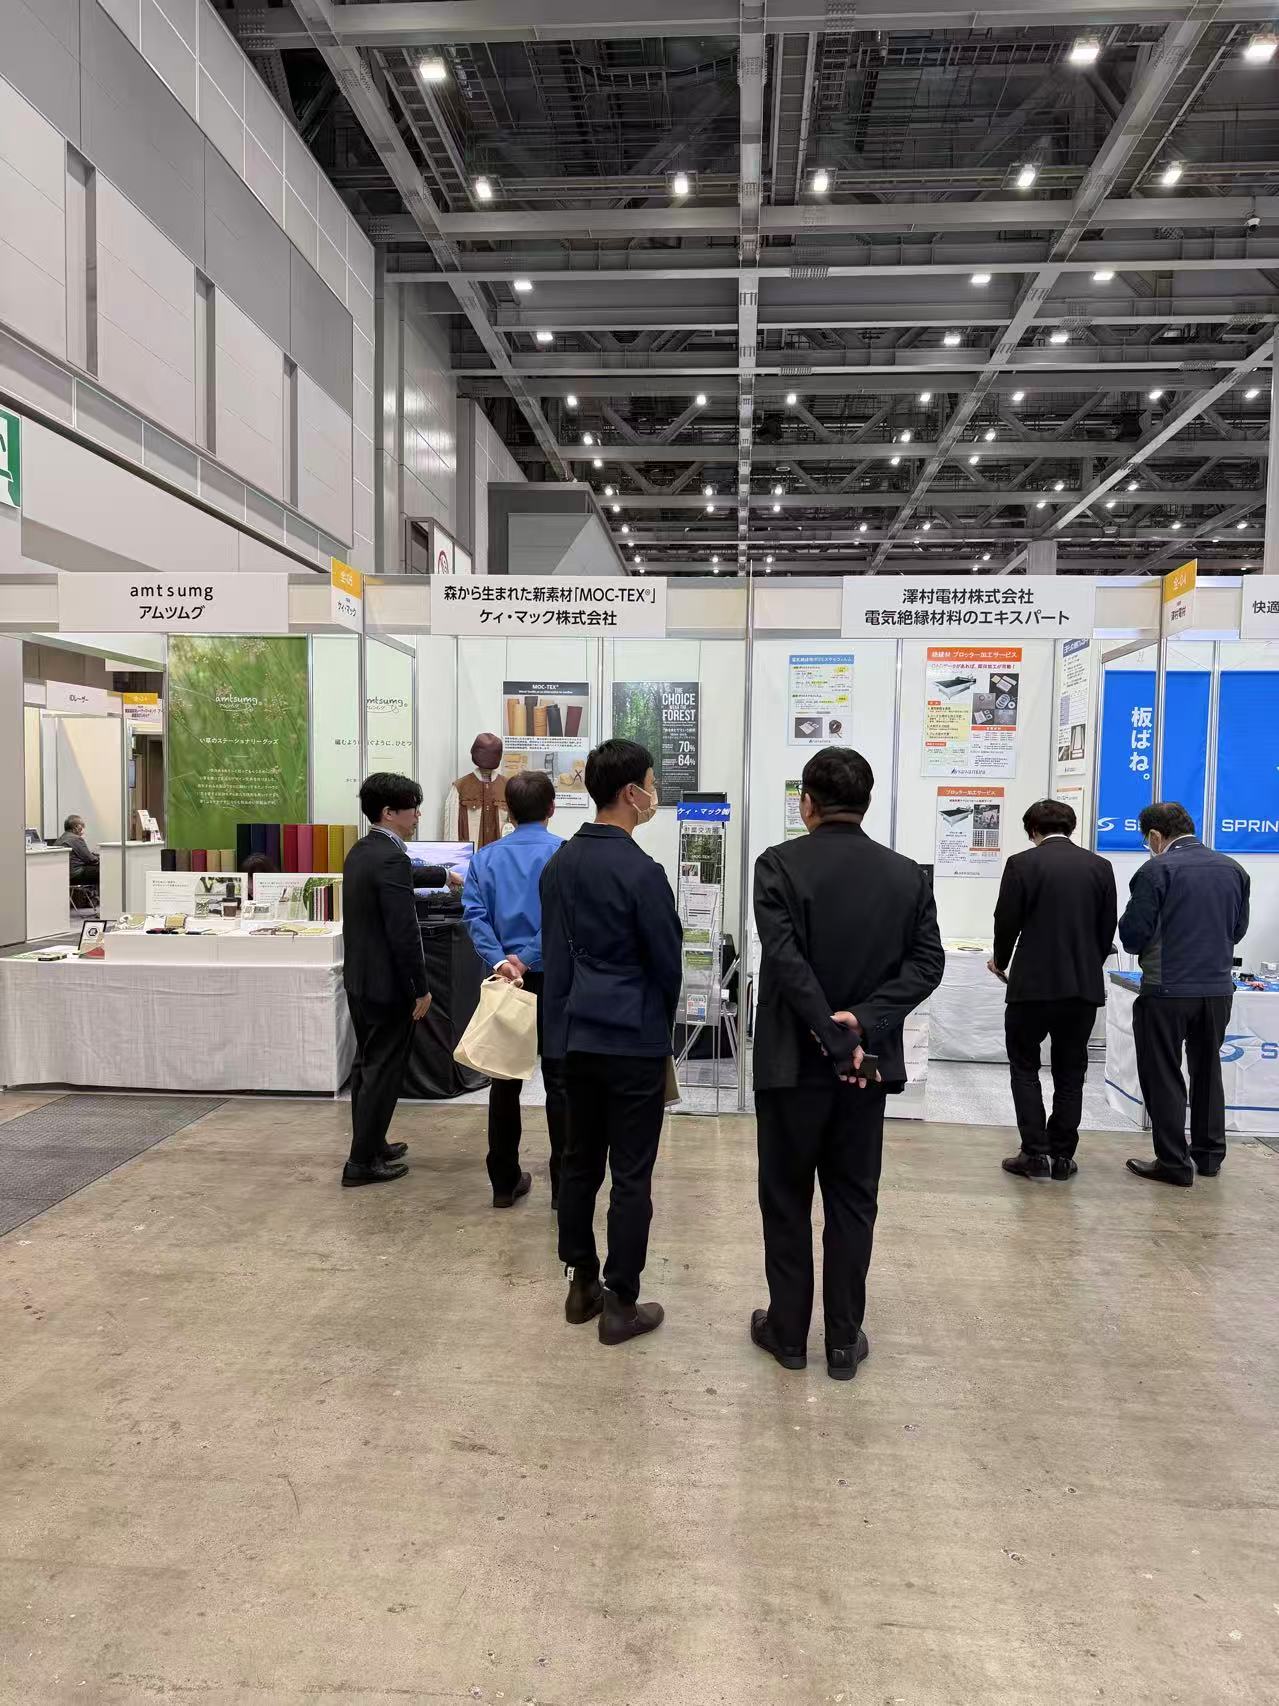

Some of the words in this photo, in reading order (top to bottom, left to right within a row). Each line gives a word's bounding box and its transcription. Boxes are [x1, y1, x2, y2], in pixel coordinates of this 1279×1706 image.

[902, 588, 1034, 605] 澤村電材株式会社
[139, 605, 206, 620] アムツムグ
[479, 609, 617, 626] ケィ・マック株式会社
[864, 609, 1071, 626] 電気絶縁材料のエキスパート
[662, 693, 696, 706] CHOICE
[662, 710, 696, 722] FOREST
[678, 741, 696, 752] 70%
[1128, 706, 1153, 781] 板ばね。
[678, 754, 696, 766] 64%
[1125, 819, 1140, 832] S
[1221, 819, 1279, 832] SPRIN
